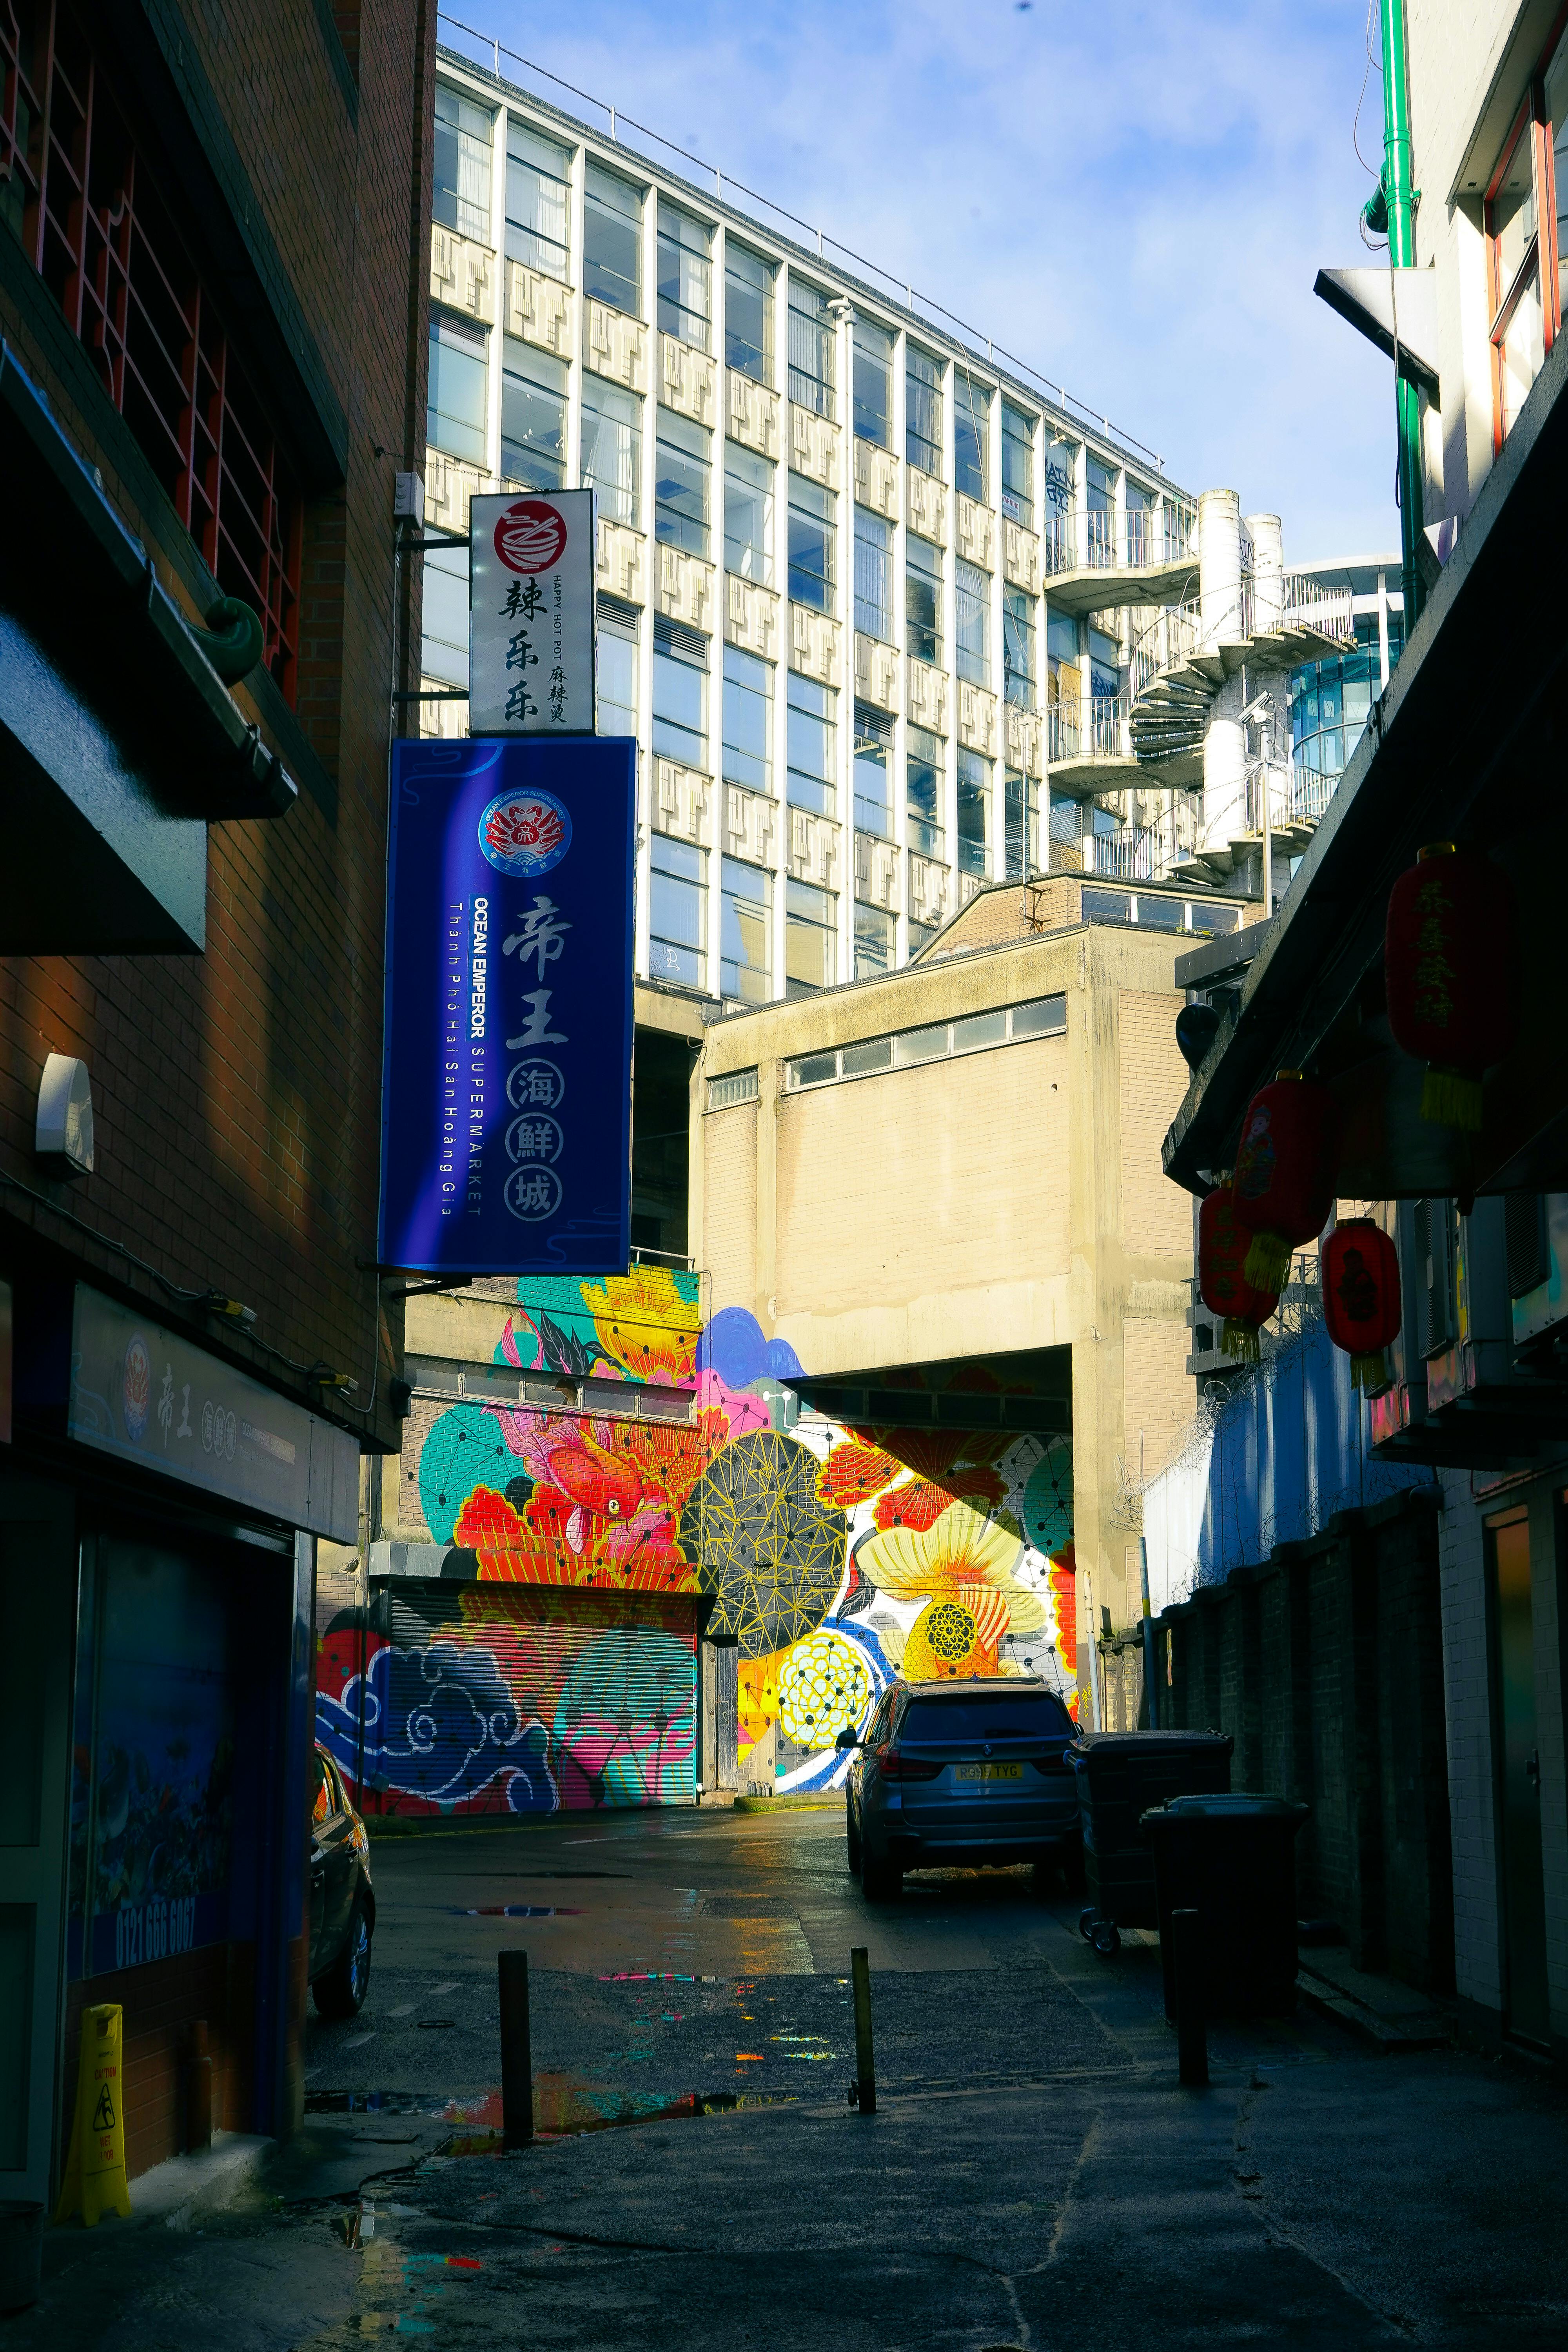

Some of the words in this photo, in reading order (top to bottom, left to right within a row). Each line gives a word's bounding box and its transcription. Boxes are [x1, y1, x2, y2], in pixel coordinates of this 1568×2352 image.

[553, 575, 561, 609] HAPPY
[498, 577, 548, 722] 辣乐乐
[553, 614, 561, 635] HOT
[546, 665, 568, 722] 麻辣烫
[485, 802, 500, 821] OCEAN
[499, 791, 528, 804] EMPEROR
[530, 791, 565, 819] SUPERMARKET
[473, 897, 488, 954] OCEAN
[471, 958, 486, 1038] EMPEROR
[440, 1107, 457, 1171] Hoàng
[468, 1047, 485, 1215] SUPERMARKET
[442, 1182, 455, 1215] Gia
[995, 1766, 1017, 1777] TYG
[116, 1907, 143, 1968] 0121
[146, 1902, 167, 1960] 666
[170, 1897, 195, 1954] 6067
[100, 2135, 111, 2147] WET
